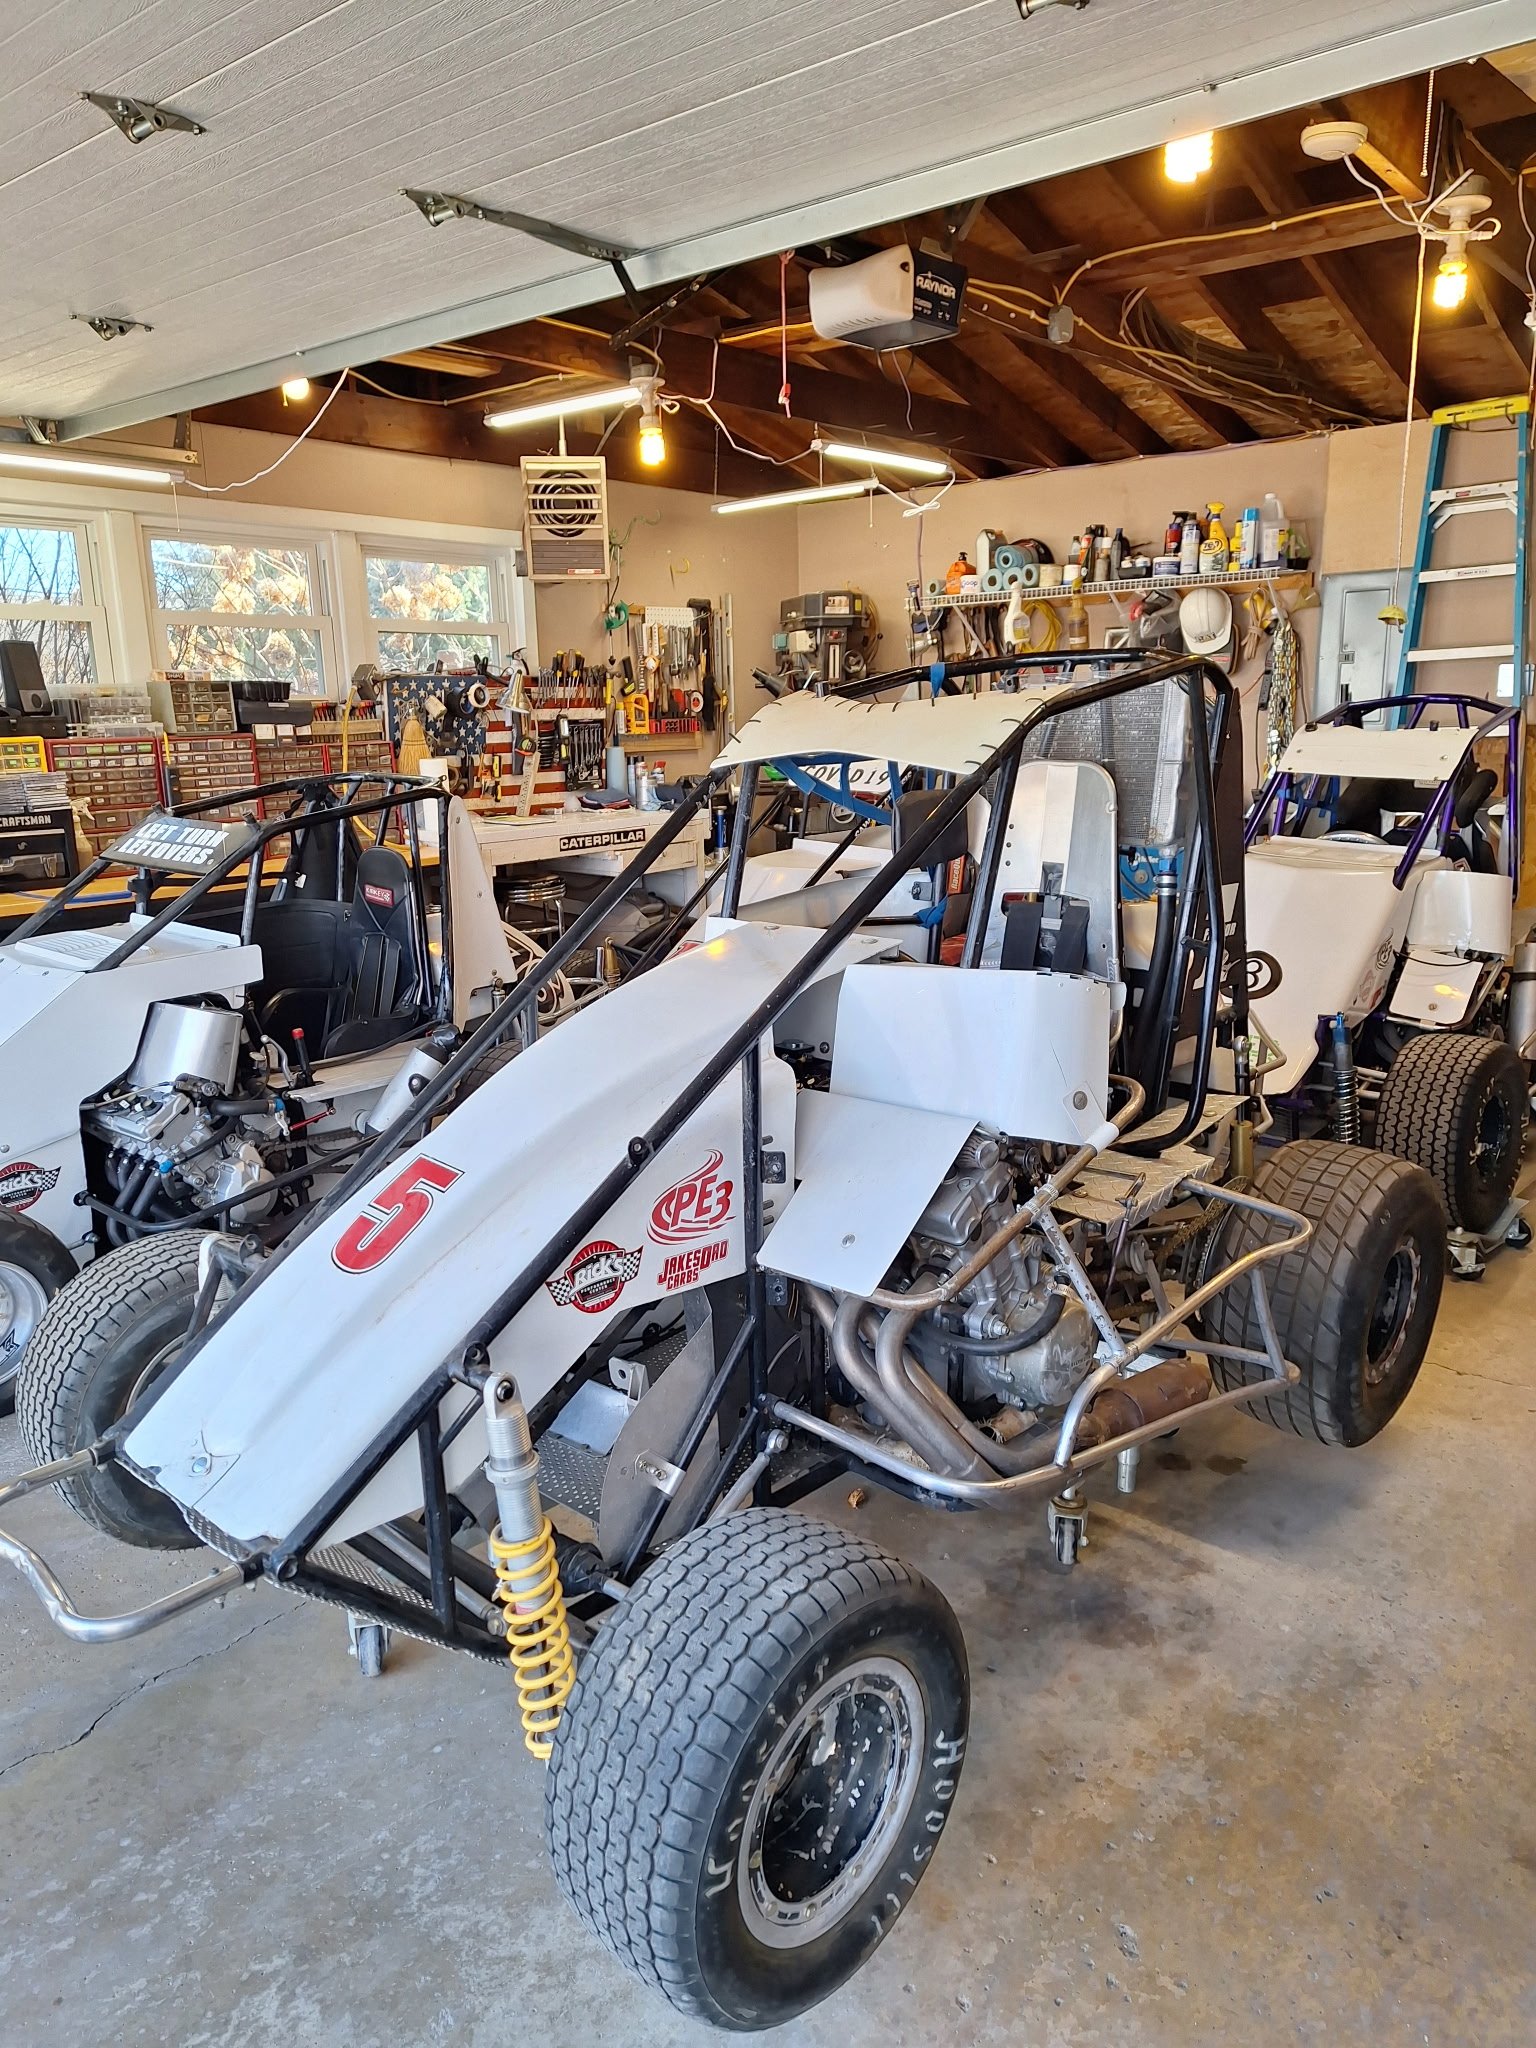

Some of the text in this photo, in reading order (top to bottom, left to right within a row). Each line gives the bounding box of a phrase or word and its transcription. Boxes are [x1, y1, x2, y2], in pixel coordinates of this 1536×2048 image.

[916, 275, 956, 300] RAYNOR
[804, 765, 889, 786] COVD19
[135, 823, 229, 848] LEFT TURN
[560, 830, 644, 849] CATERPILLAR
[118, 837, 214, 865] LEFTOVERS
[331, 1154, 465, 1274] 5
[570, 1254, 624, 1296] Rick's
[666, 1269, 700, 1291] CARBS
